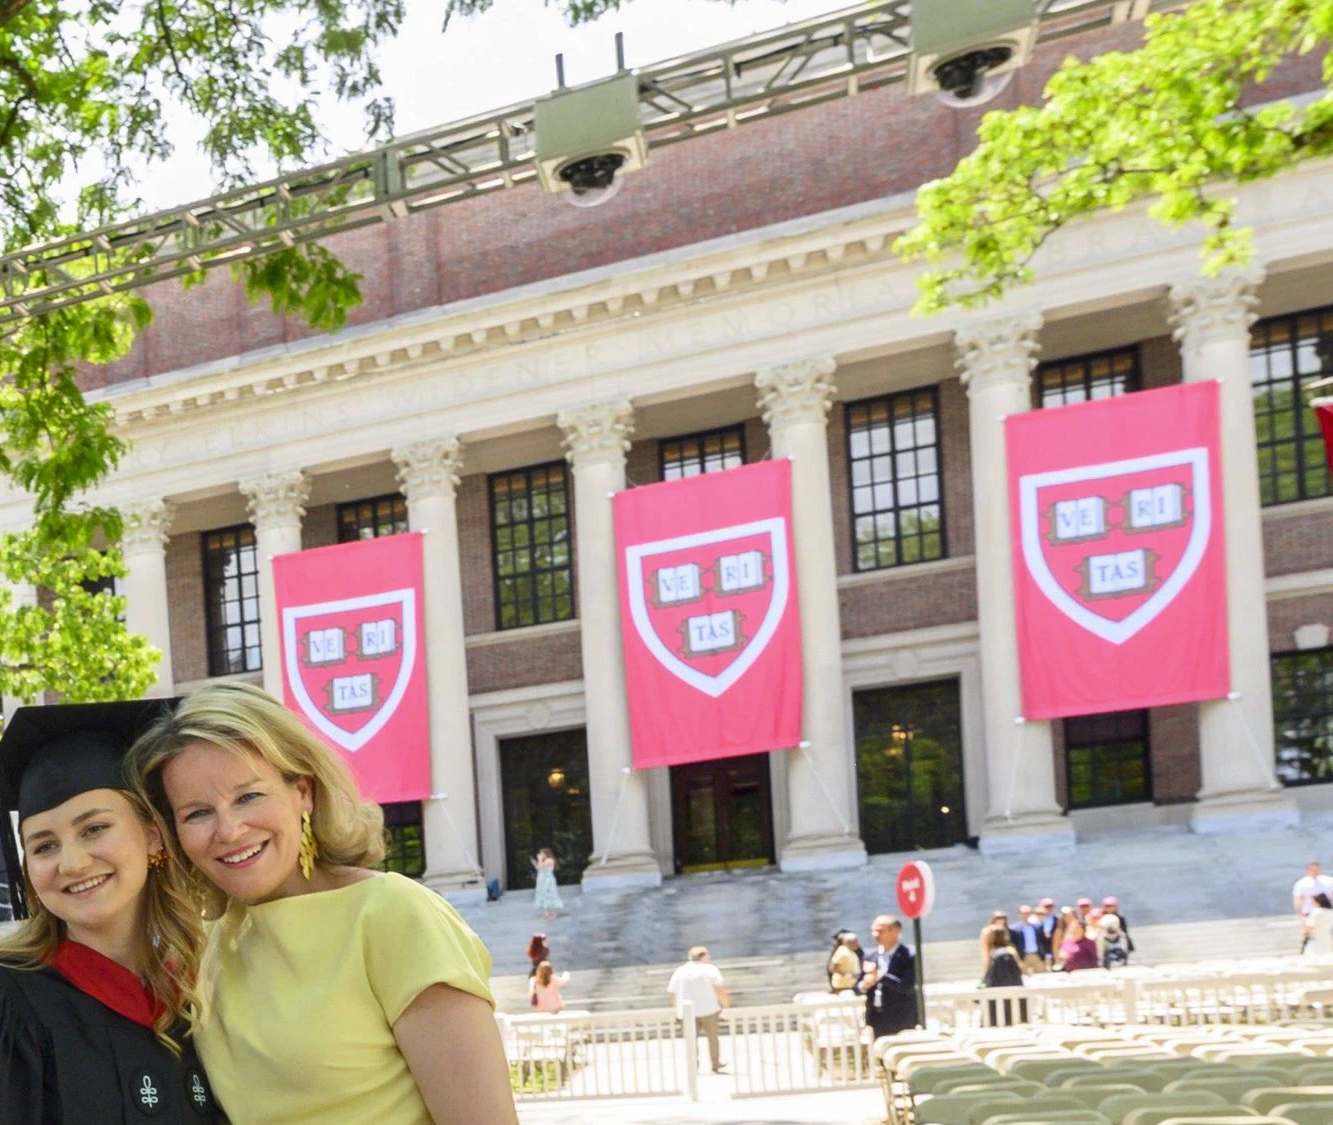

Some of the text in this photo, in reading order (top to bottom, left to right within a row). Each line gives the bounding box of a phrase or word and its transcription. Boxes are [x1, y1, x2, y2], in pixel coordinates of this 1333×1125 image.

[1095, 561, 1141, 583] TAS
[695, 620, 731, 641] TAS
[338, 682, 369, 701] TAS
